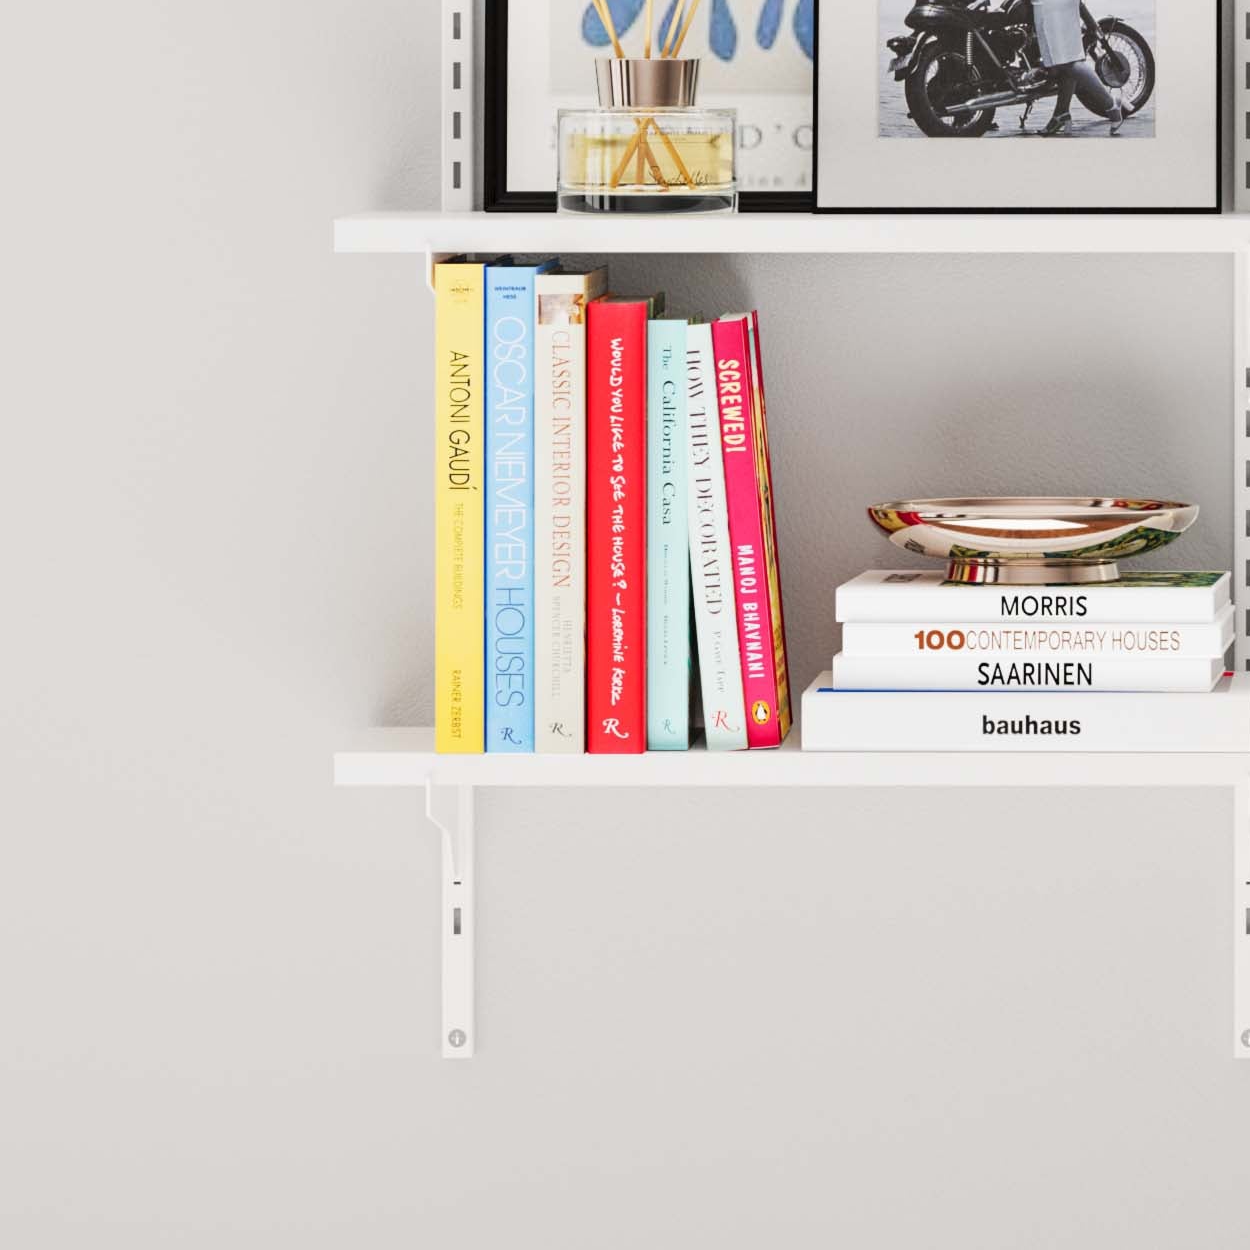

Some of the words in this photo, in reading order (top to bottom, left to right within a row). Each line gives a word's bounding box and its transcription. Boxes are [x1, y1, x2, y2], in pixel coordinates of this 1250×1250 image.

[494, 316, 526, 426] OSCAR
[551, 330, 572, 410] CLASSIC
[609, 337, 624, 387] WOULD
[662, 346, 673, 370] The
[686, 350, 704, 398] HOW
[449, 351, 471, 423] ANTONI
[609, 388, 624, 413] YOU
[609, 416, 625, 452] LIKE
[662, 380, 677, 475] California
[689, 406, 710, 466] THEY
[449, 429, 478, 491] GAUDÍ
[551, 417, 571, 507] INTERIOR
[611, 454, 624, 472] TO
[494, 434, 527, 580] NIEMEYER
[609, 471, 625, 501] SEE
[662, 481, 676, 525] Casa
[611, 505, 625, 533] THE
[551, 515, 571, 588] DESIGN
[696, 477, 723, 614] DECORATED
[737, 544, 757, 594] MANOJ
[1001, 595, 1088, 617] MORRIS
[495, 587, 526, 707] HOUSES
[741, 602, 765, 679] BHAVNANI
[1111, 630, 1181, 651] HOUSES
[977, 662, 1093, 686] SAARINEN
[982, 715, 1081, 735] bauhaus
